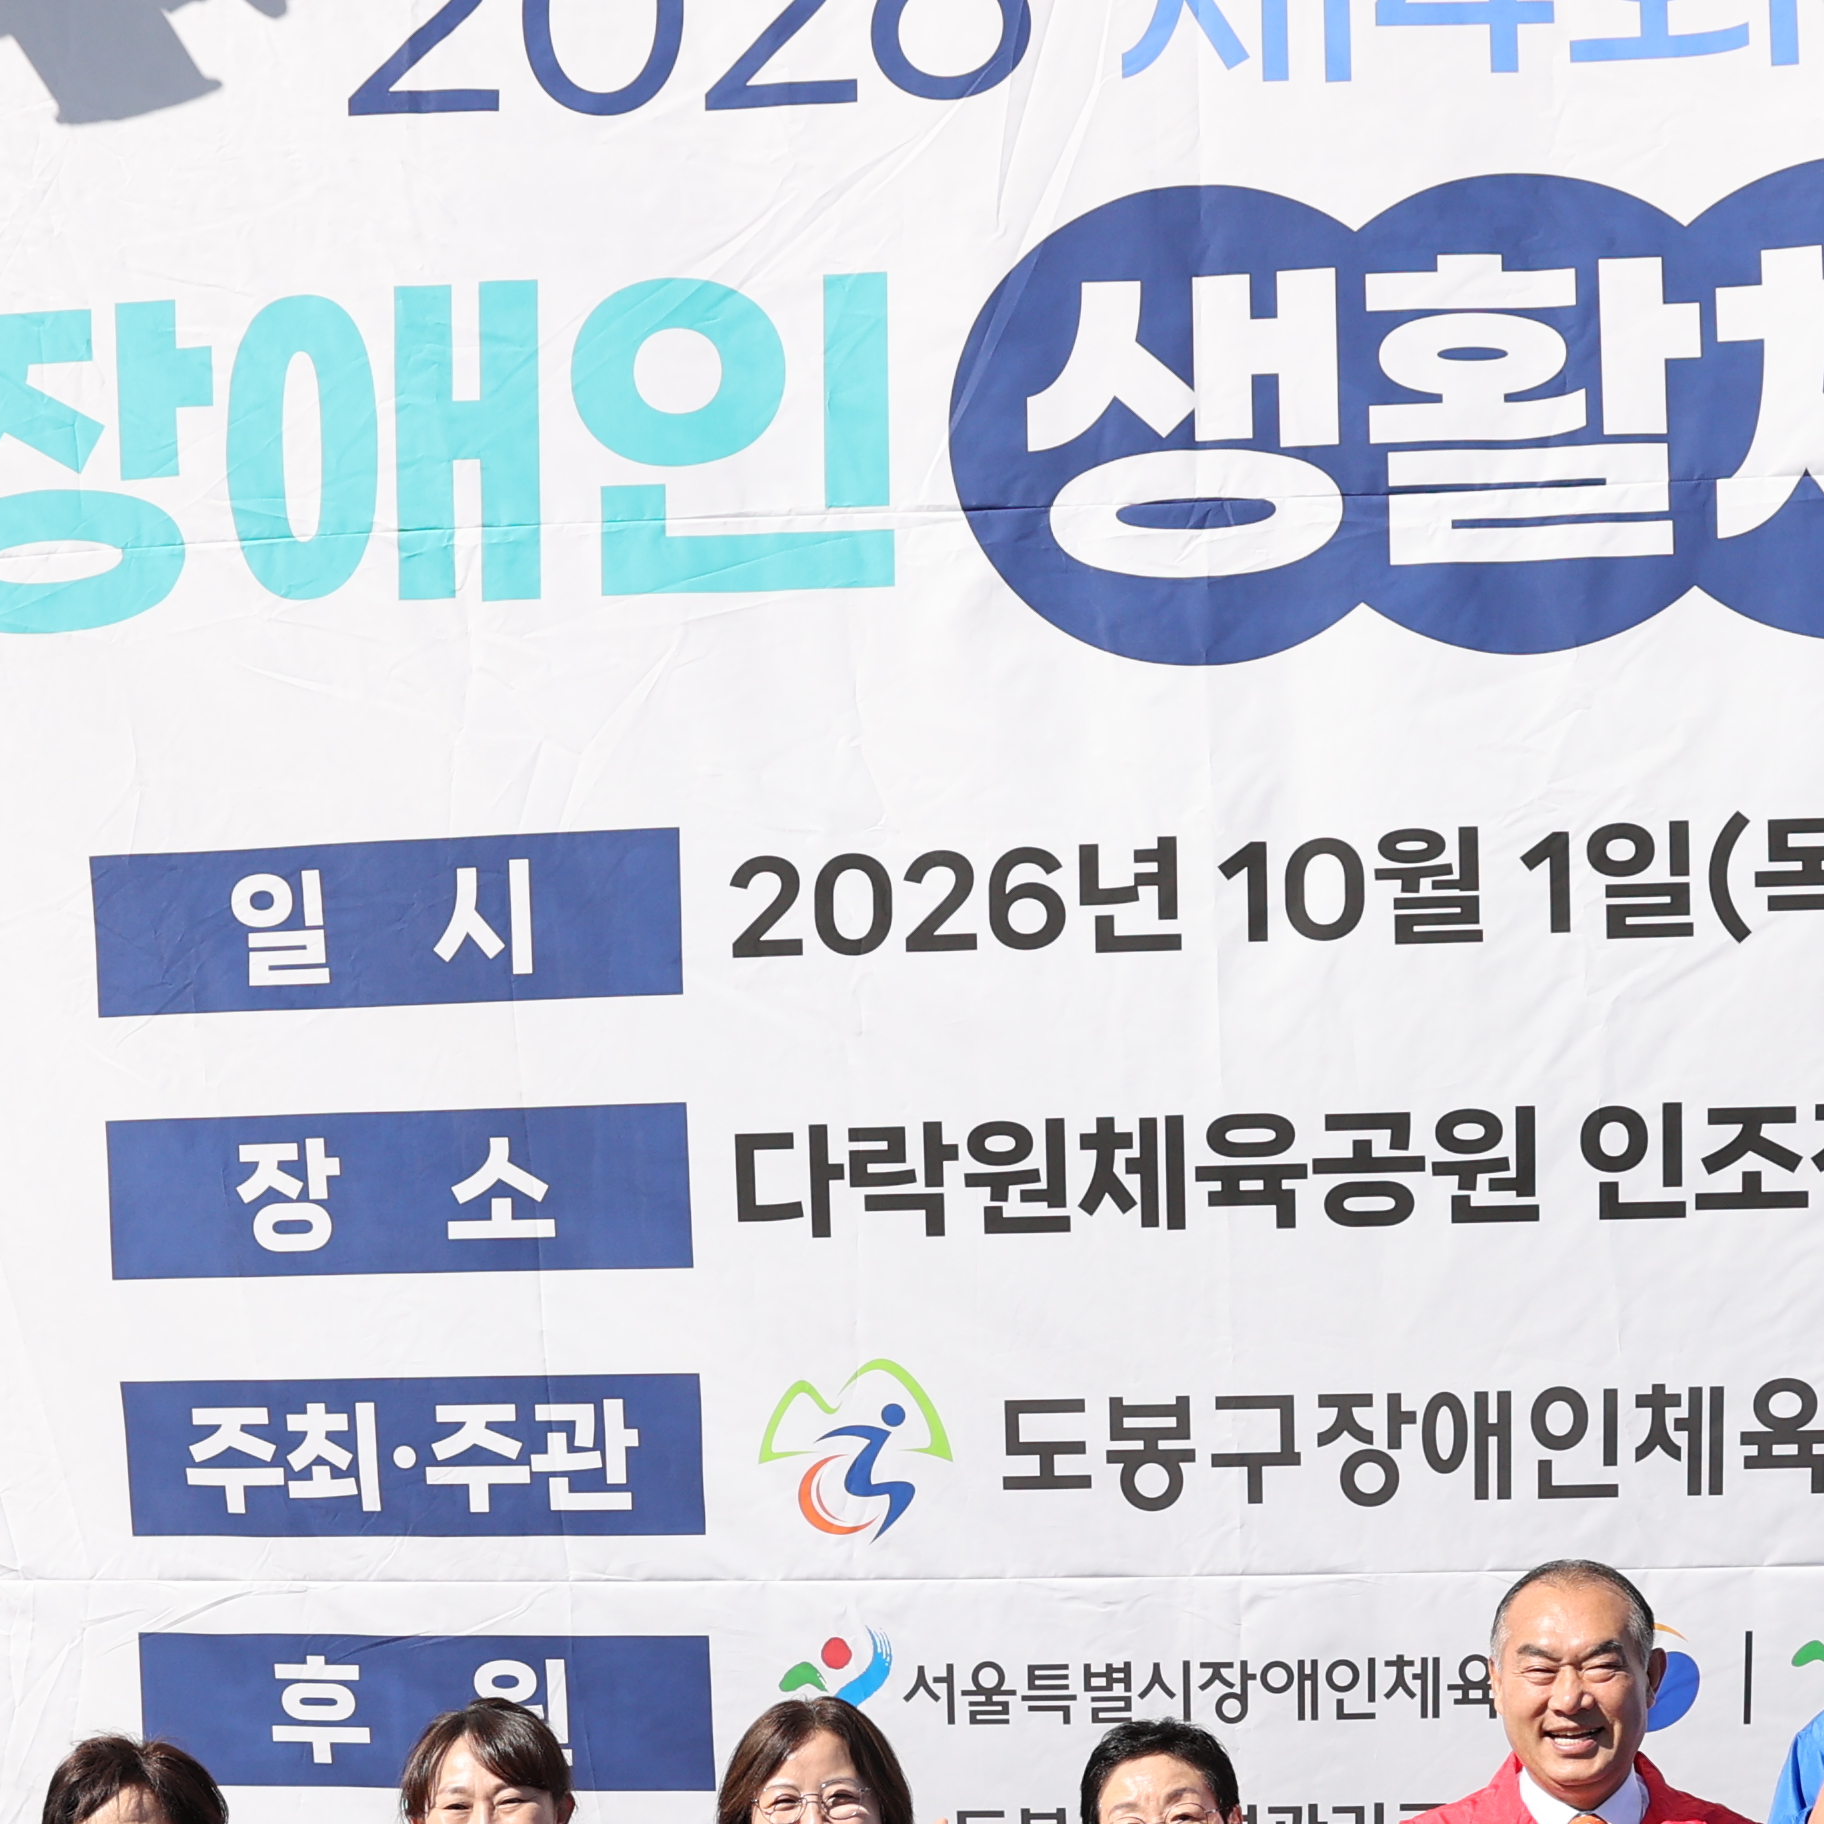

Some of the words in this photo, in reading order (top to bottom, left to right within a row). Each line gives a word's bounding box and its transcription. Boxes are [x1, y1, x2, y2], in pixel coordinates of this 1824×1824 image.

[729, 835, 1184, 959] 2026년
[1217, 825, 1484, 946] 10월
[734, 1106, 1540, 1239] 다락원체육공원
[184, 1396, 640, 1516] 주최·주관
